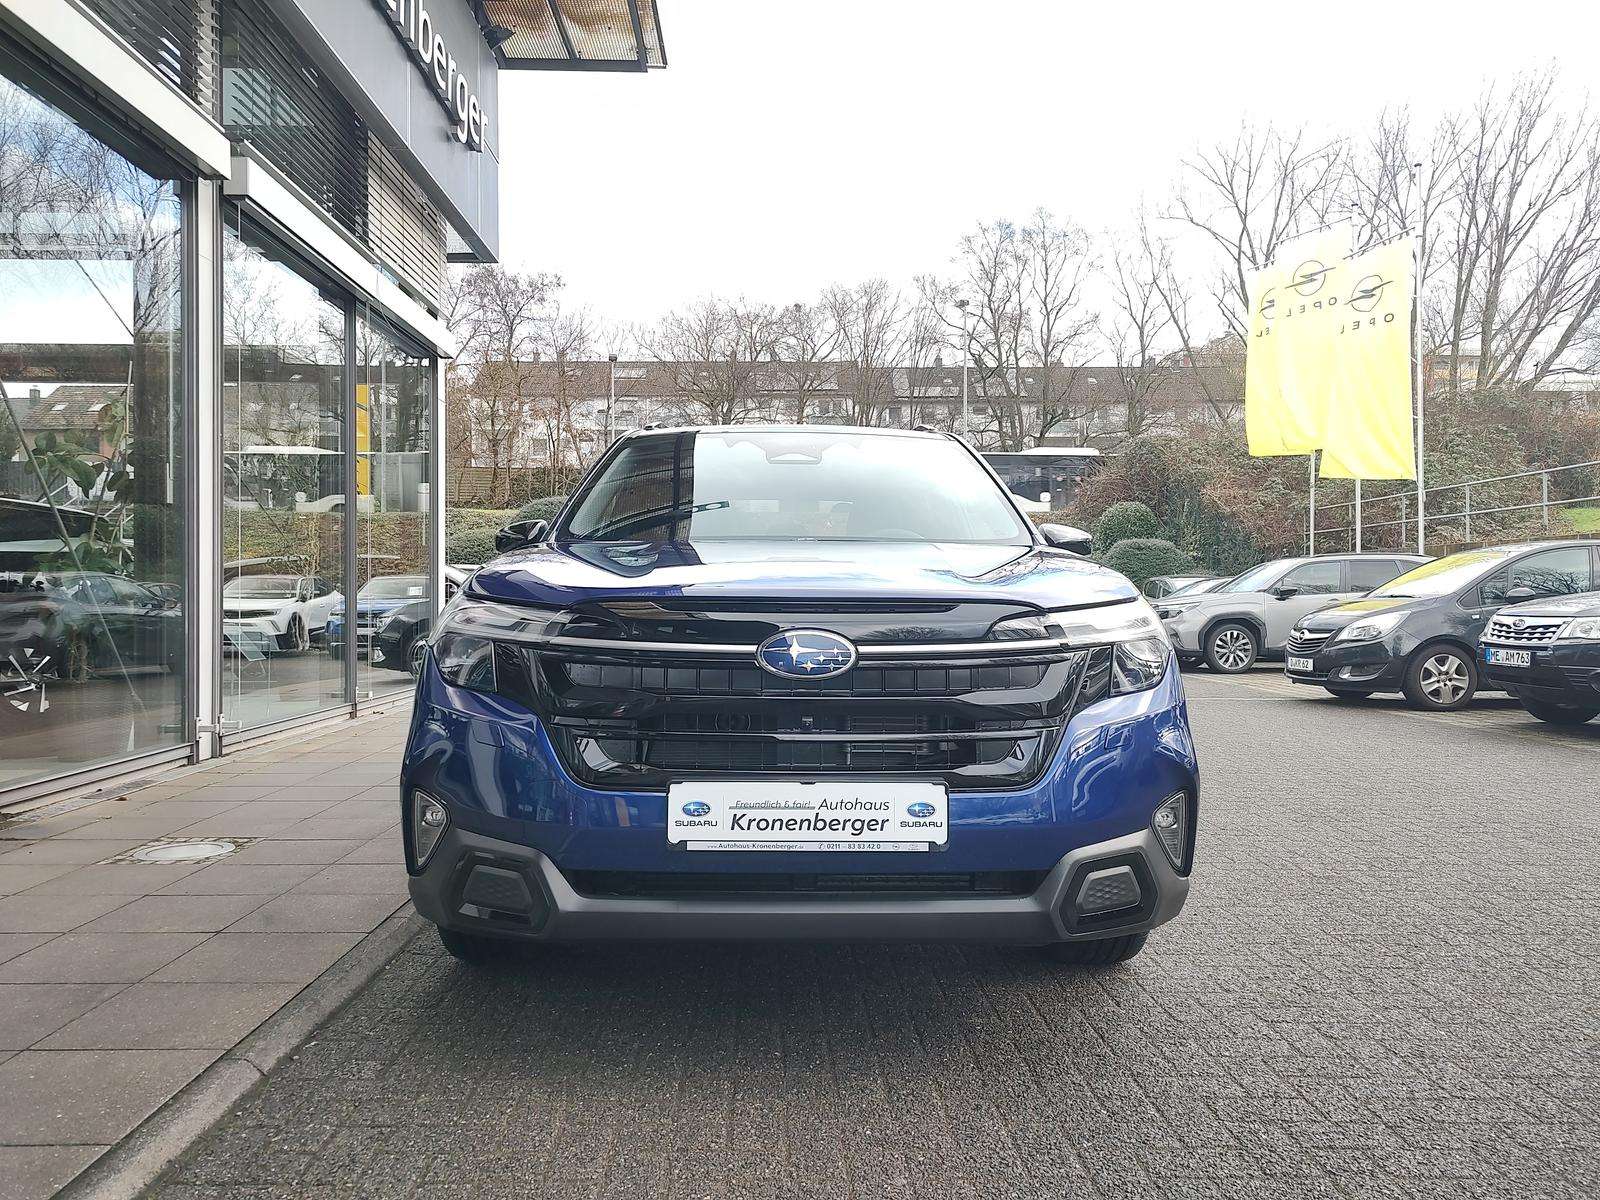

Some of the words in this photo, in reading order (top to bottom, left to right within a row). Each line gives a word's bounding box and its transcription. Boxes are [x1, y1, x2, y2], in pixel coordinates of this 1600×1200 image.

[735, 800, 782, 809] Freundlich
[792, 800, 811, 809] fair!
[818, 797, 890, 811] Autohaus
[730, 812, 890, 836] Kronenberger
